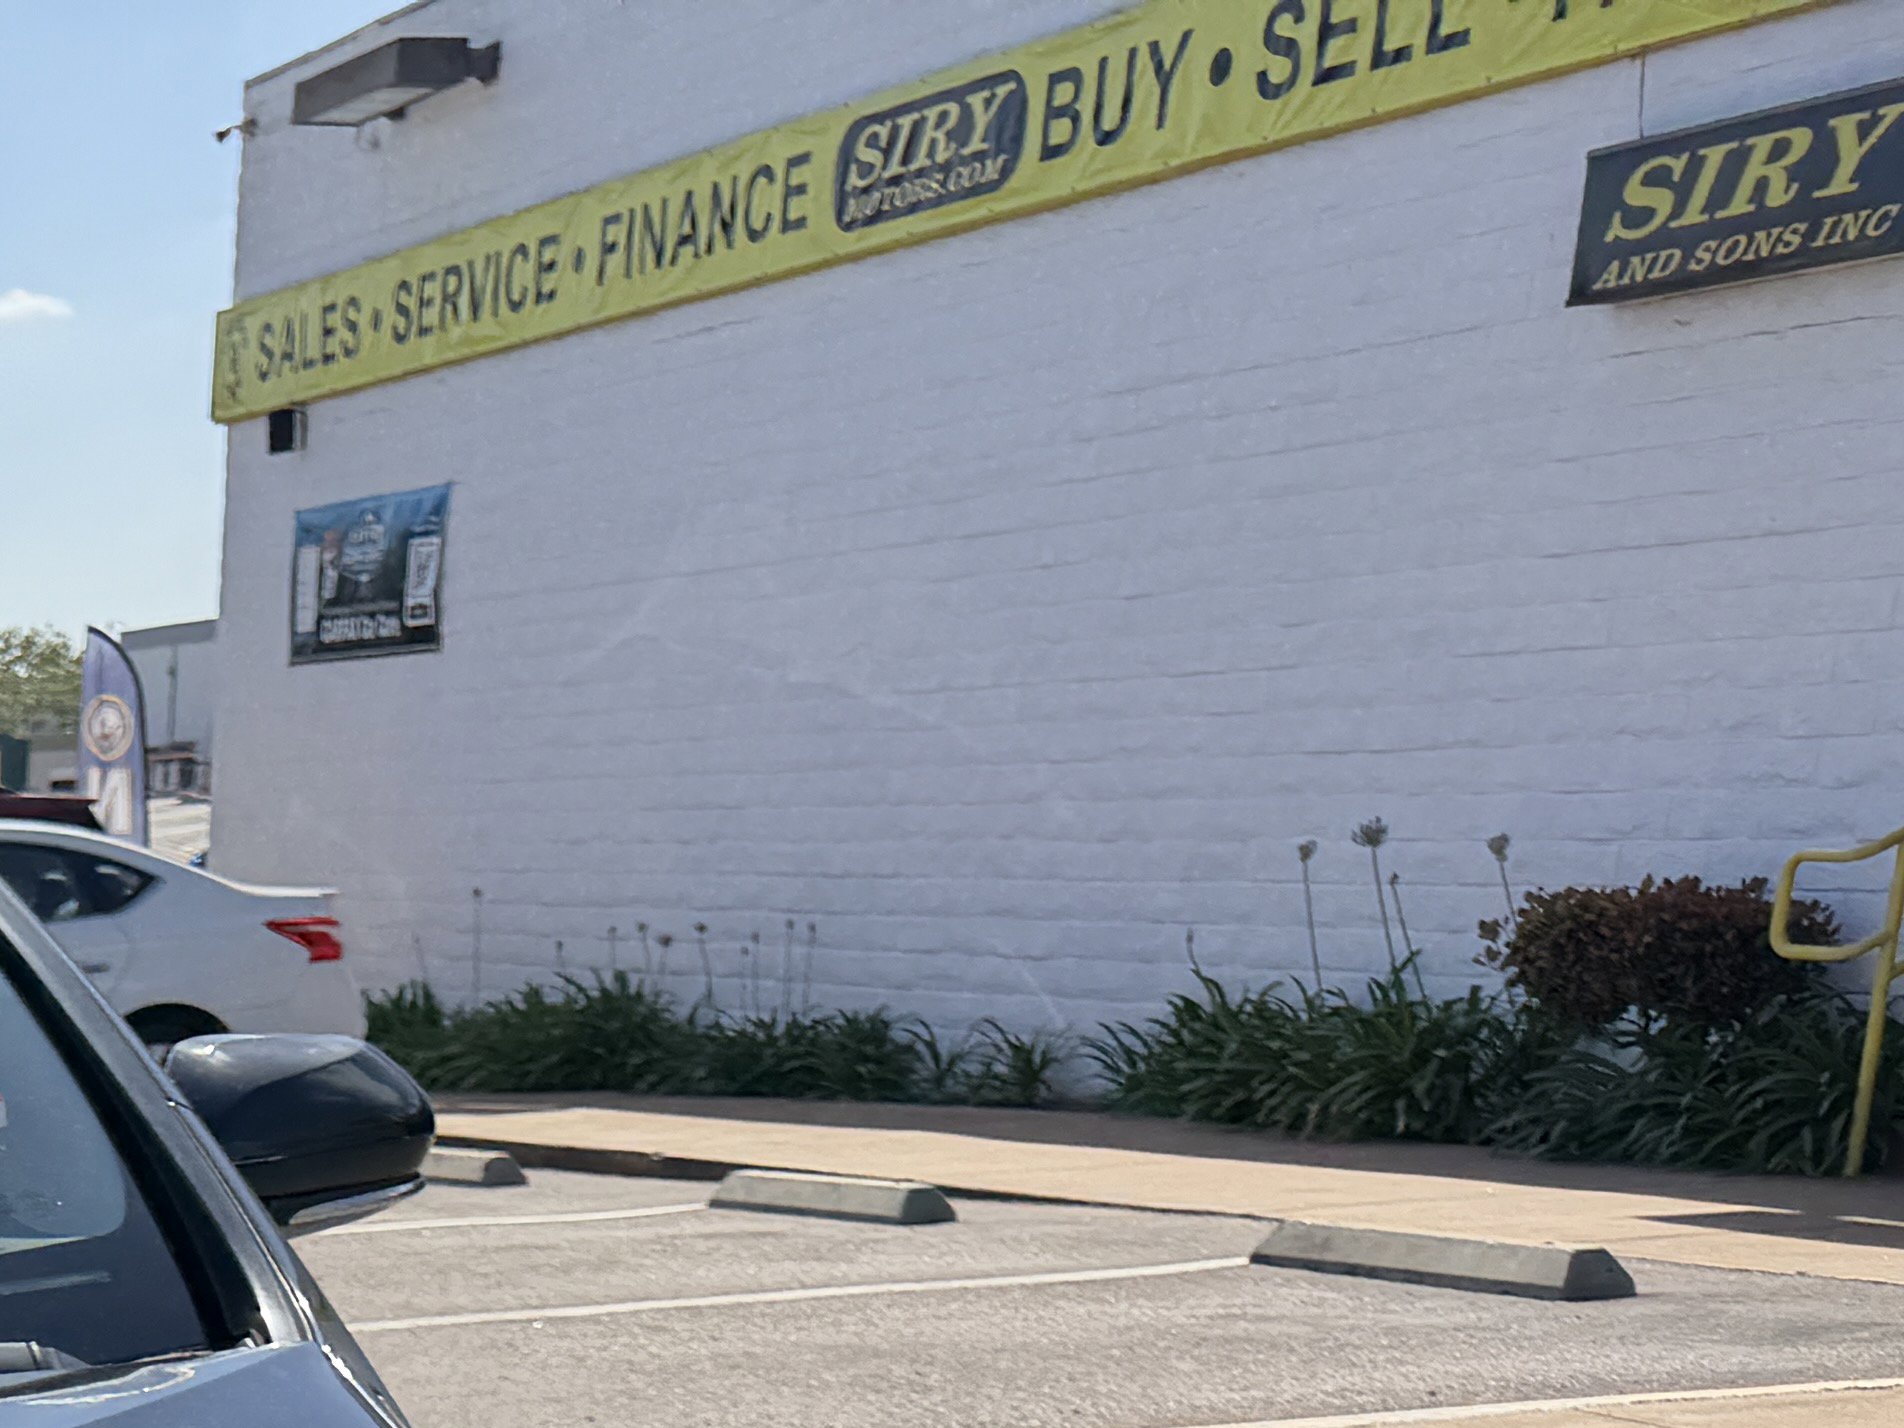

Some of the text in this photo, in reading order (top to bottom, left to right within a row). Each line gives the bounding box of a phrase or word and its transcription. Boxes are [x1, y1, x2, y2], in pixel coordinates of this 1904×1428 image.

[847, 81, 1018, 190] SIRY
[1040, 0, 1471, 162] BUY SELL
[843, 155, 1010, 224] MOTORS.COM
[1603, 102, 1904, 243] SIRY
[255, 296, 360, 383] SALES
[392, 234, 562, 345] SERVICE
[596, 151, 812, 286] FINANCE
[1592, 204, 1904, 290] AND SONS INC
